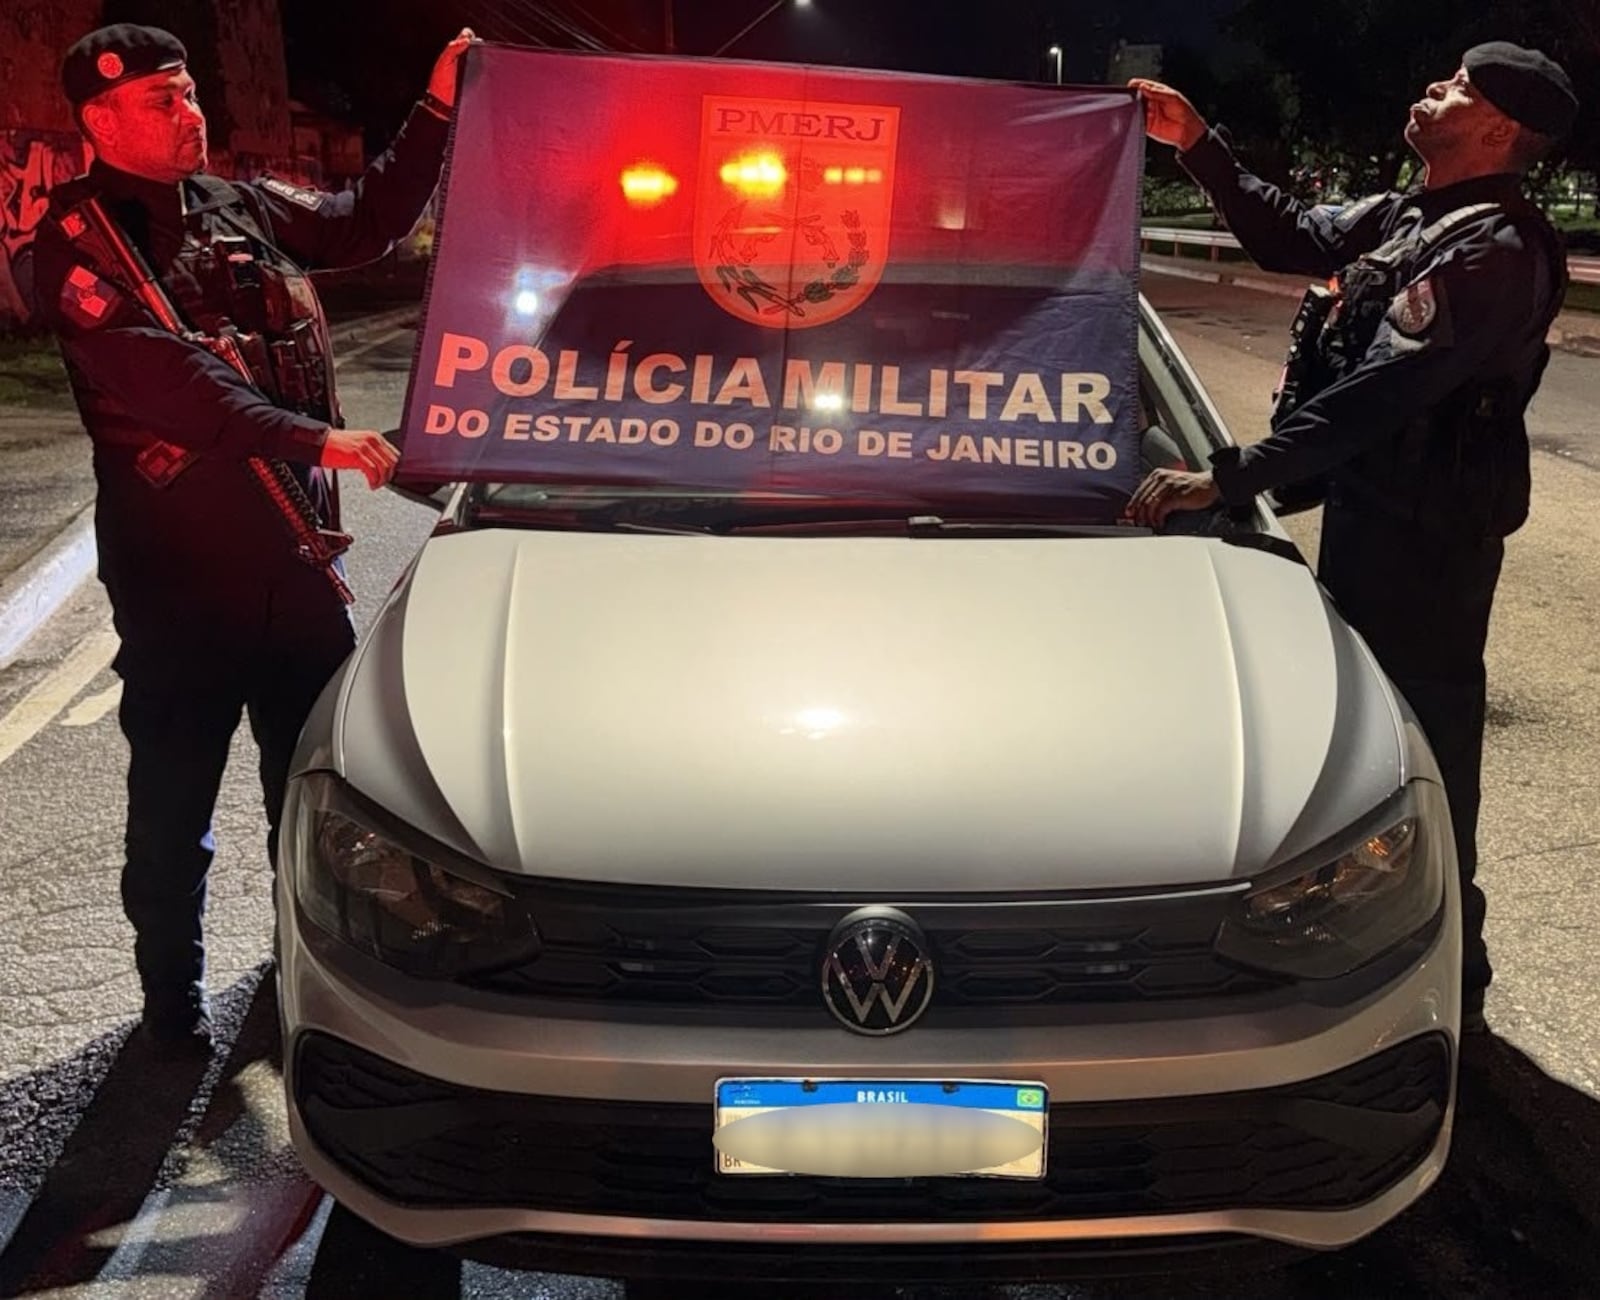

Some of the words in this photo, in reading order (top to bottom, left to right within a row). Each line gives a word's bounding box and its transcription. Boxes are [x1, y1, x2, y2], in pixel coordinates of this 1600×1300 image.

[716, 107, 885, 141] PMERJ
[434, 332, 771, 409] POLÍCIA
[782, 359, 1114, 424] MILITAR
[424, 404, 490, 439] DO
[503, 413, 680, 446] ESTADO
[694, 420, 754, 450] DO
[768, 425, 843, 455] RIO
[858, 430, 913, 459] DE
[926, 434, 1117, 471] JANEIRO
[856, 1090, 909, 1104] BRASIL
